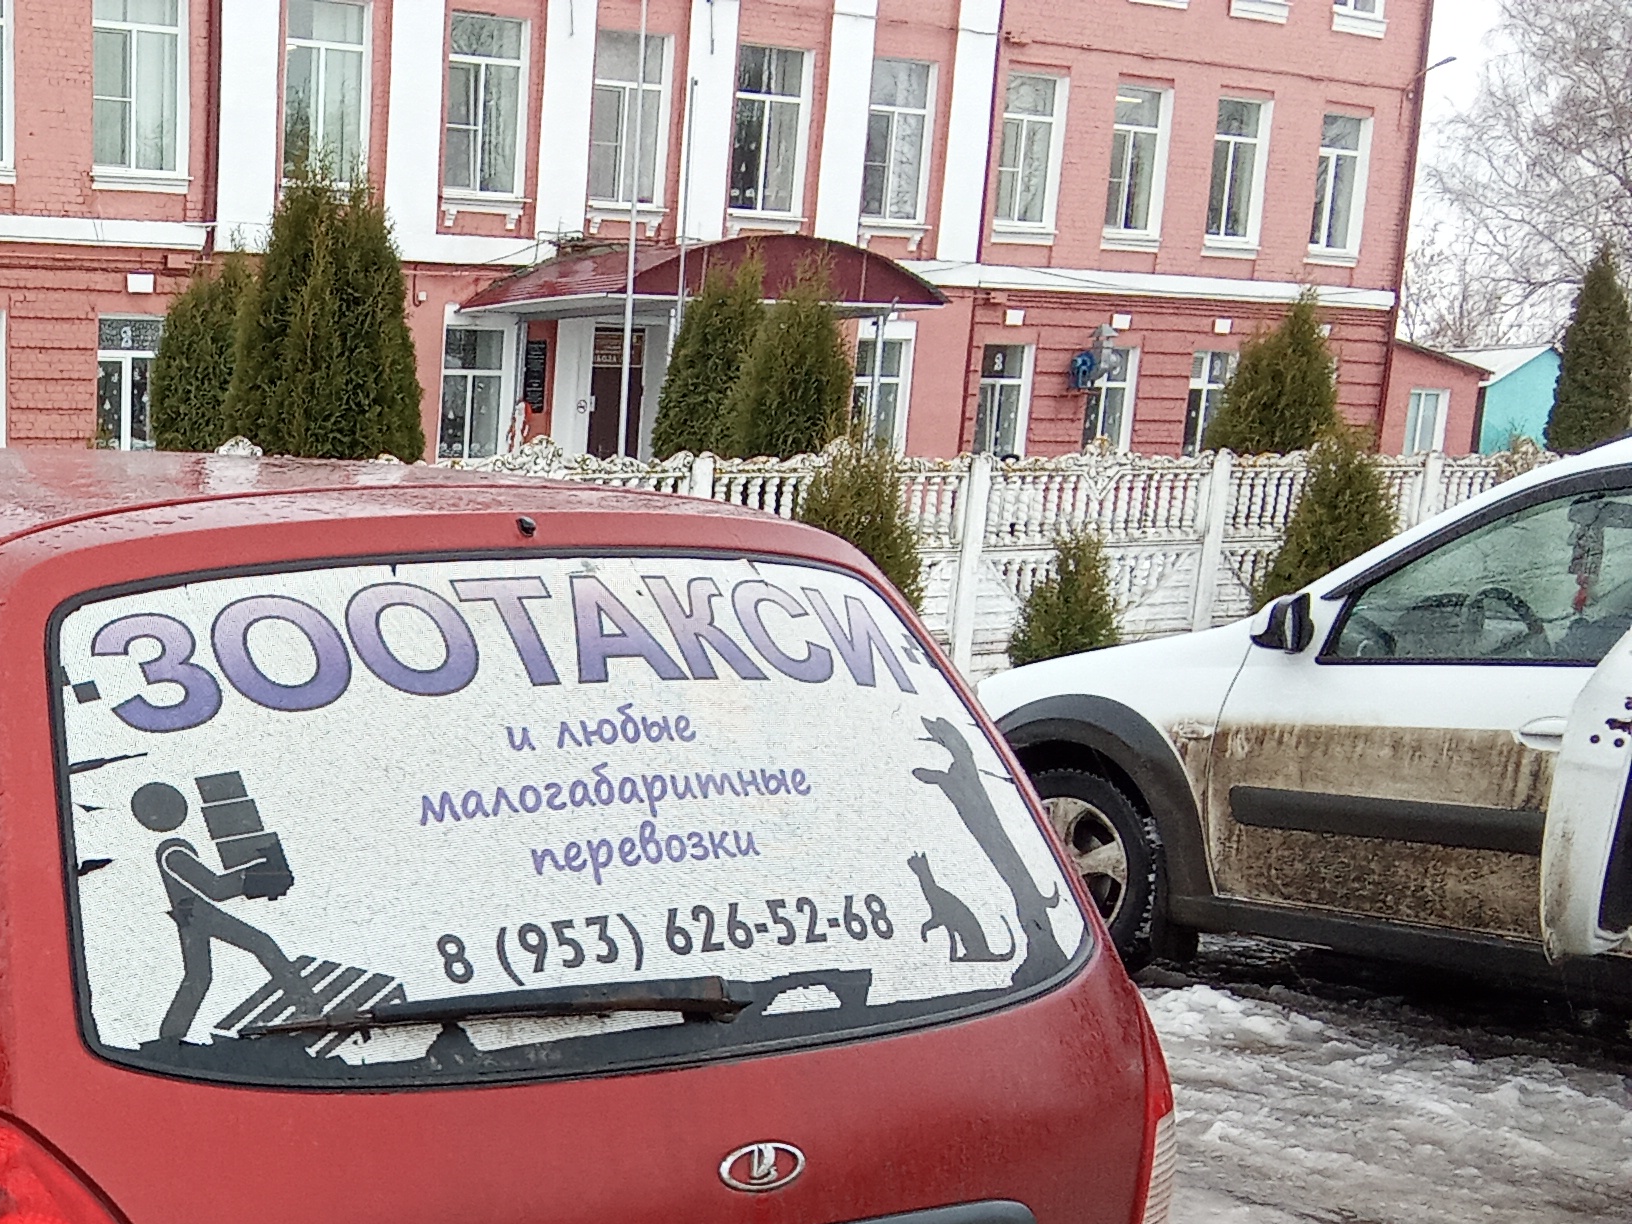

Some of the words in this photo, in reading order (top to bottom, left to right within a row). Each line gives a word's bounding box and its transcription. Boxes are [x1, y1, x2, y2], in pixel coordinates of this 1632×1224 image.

[90, 576, 919, 734] ЗООТАКСИ
[506, 725, 536, 752] и
[557, 702, 697, 750] любые
[419, 761, 812, 827] малогабаритные
[530, 819, 762, 886] перевозки
[436, 933, 475, 985] 8
[496, 912, 645, 987] (953)
[665, 893, 895, 956] 626-52-68
